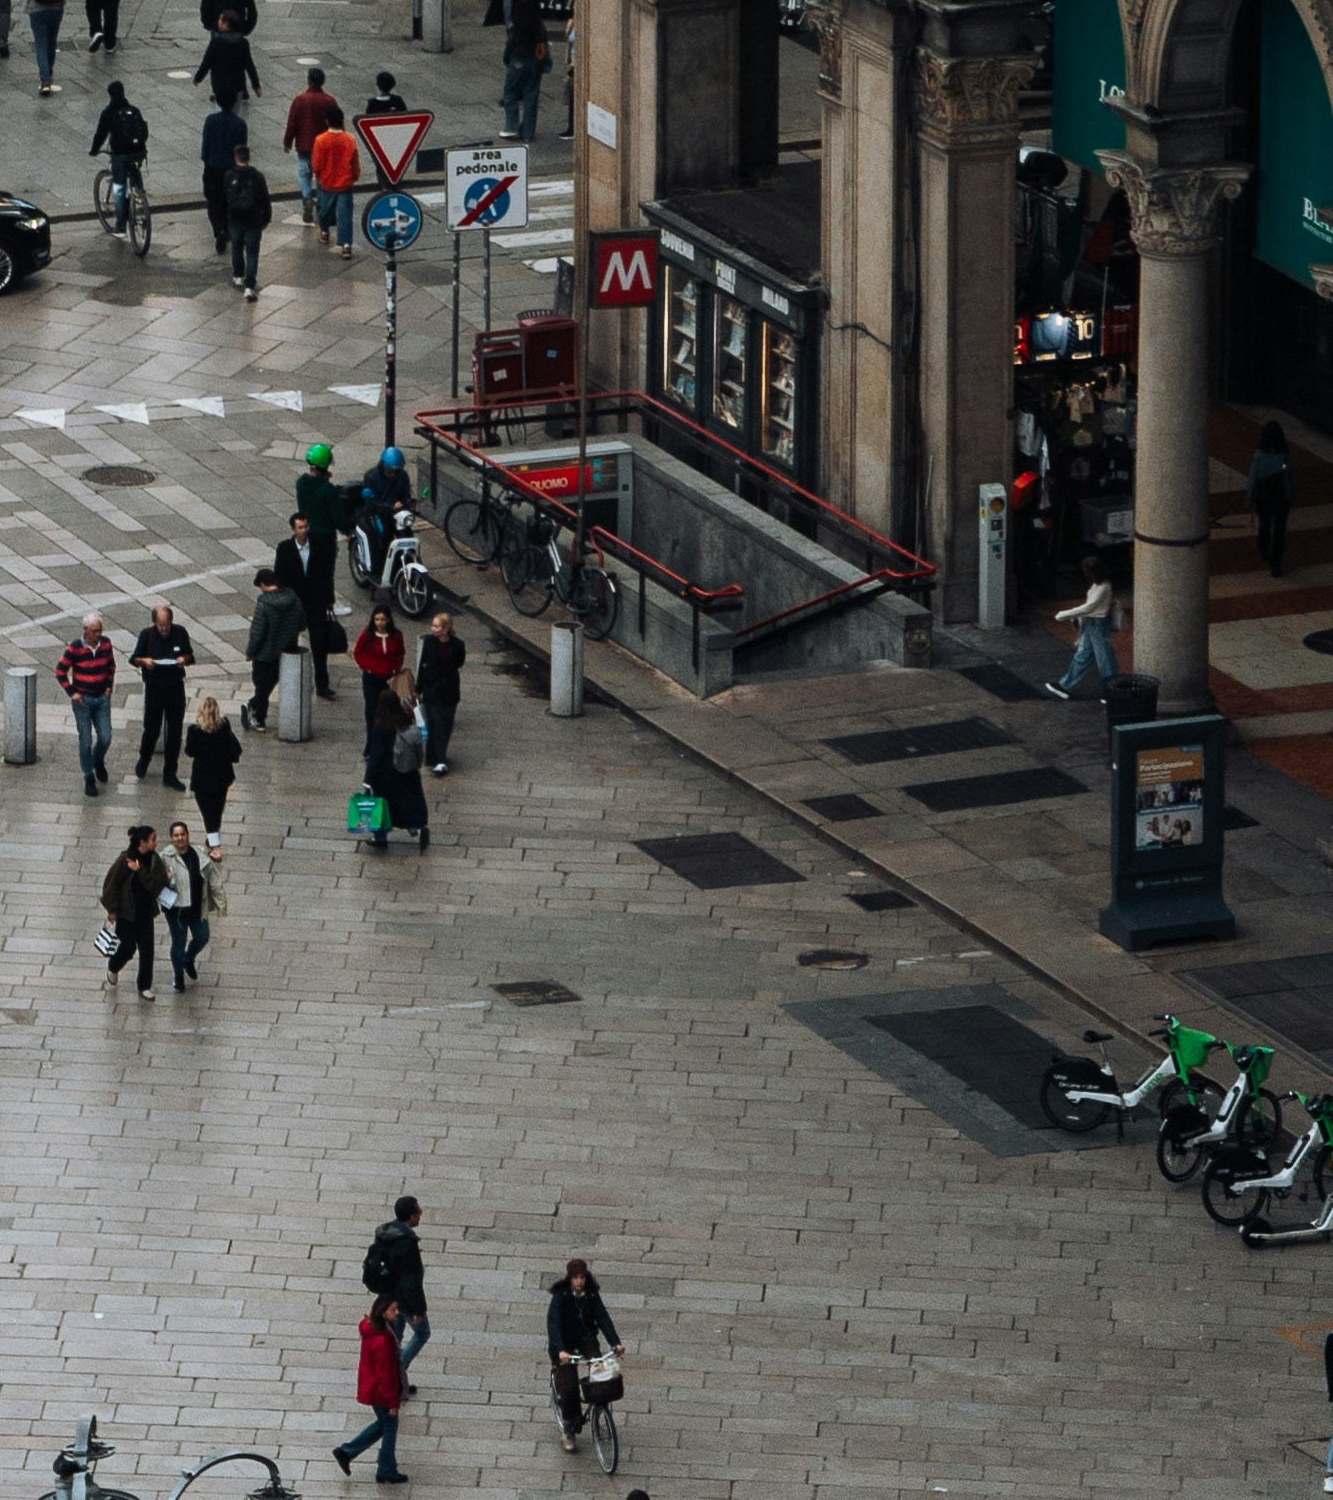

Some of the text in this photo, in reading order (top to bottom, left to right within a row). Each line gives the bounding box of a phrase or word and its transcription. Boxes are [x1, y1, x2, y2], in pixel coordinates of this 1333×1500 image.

[472, 150, 502, 161] area
[456, 161, 518, 176] pedonale
[600, 250, 653, 293] M
[1075, 319, 1095, 341] 10
